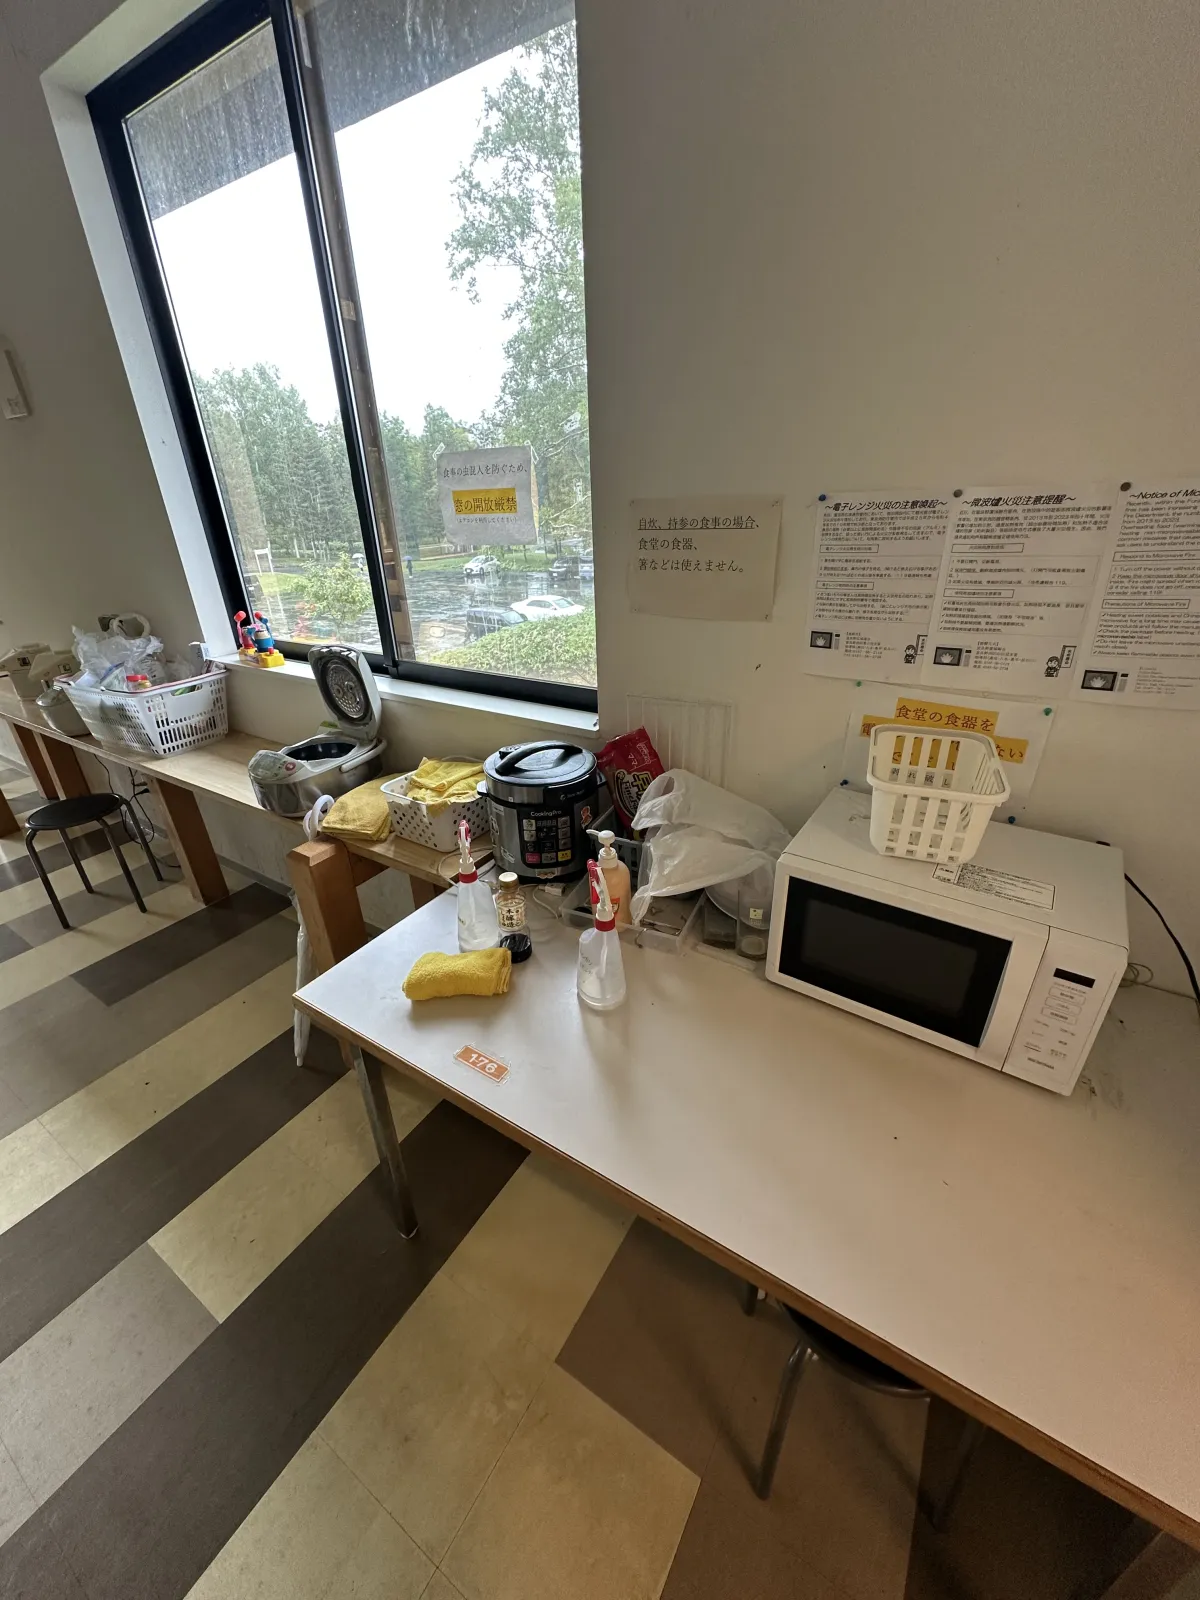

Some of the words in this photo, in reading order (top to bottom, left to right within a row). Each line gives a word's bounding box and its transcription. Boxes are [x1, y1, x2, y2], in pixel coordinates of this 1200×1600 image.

[453, 496, 517, 513] 窓の開放厳禁
[638, 515, 760, 530] 自炊、持参の食事の場合、
[638, 537, 699, 551] 食堂の食器、
[638, 558, 744, 573] 箸などは使えません。
[895, 704, 995, 732] 食堂の食器を
[468, 1053, 498, 1074] 1-76
